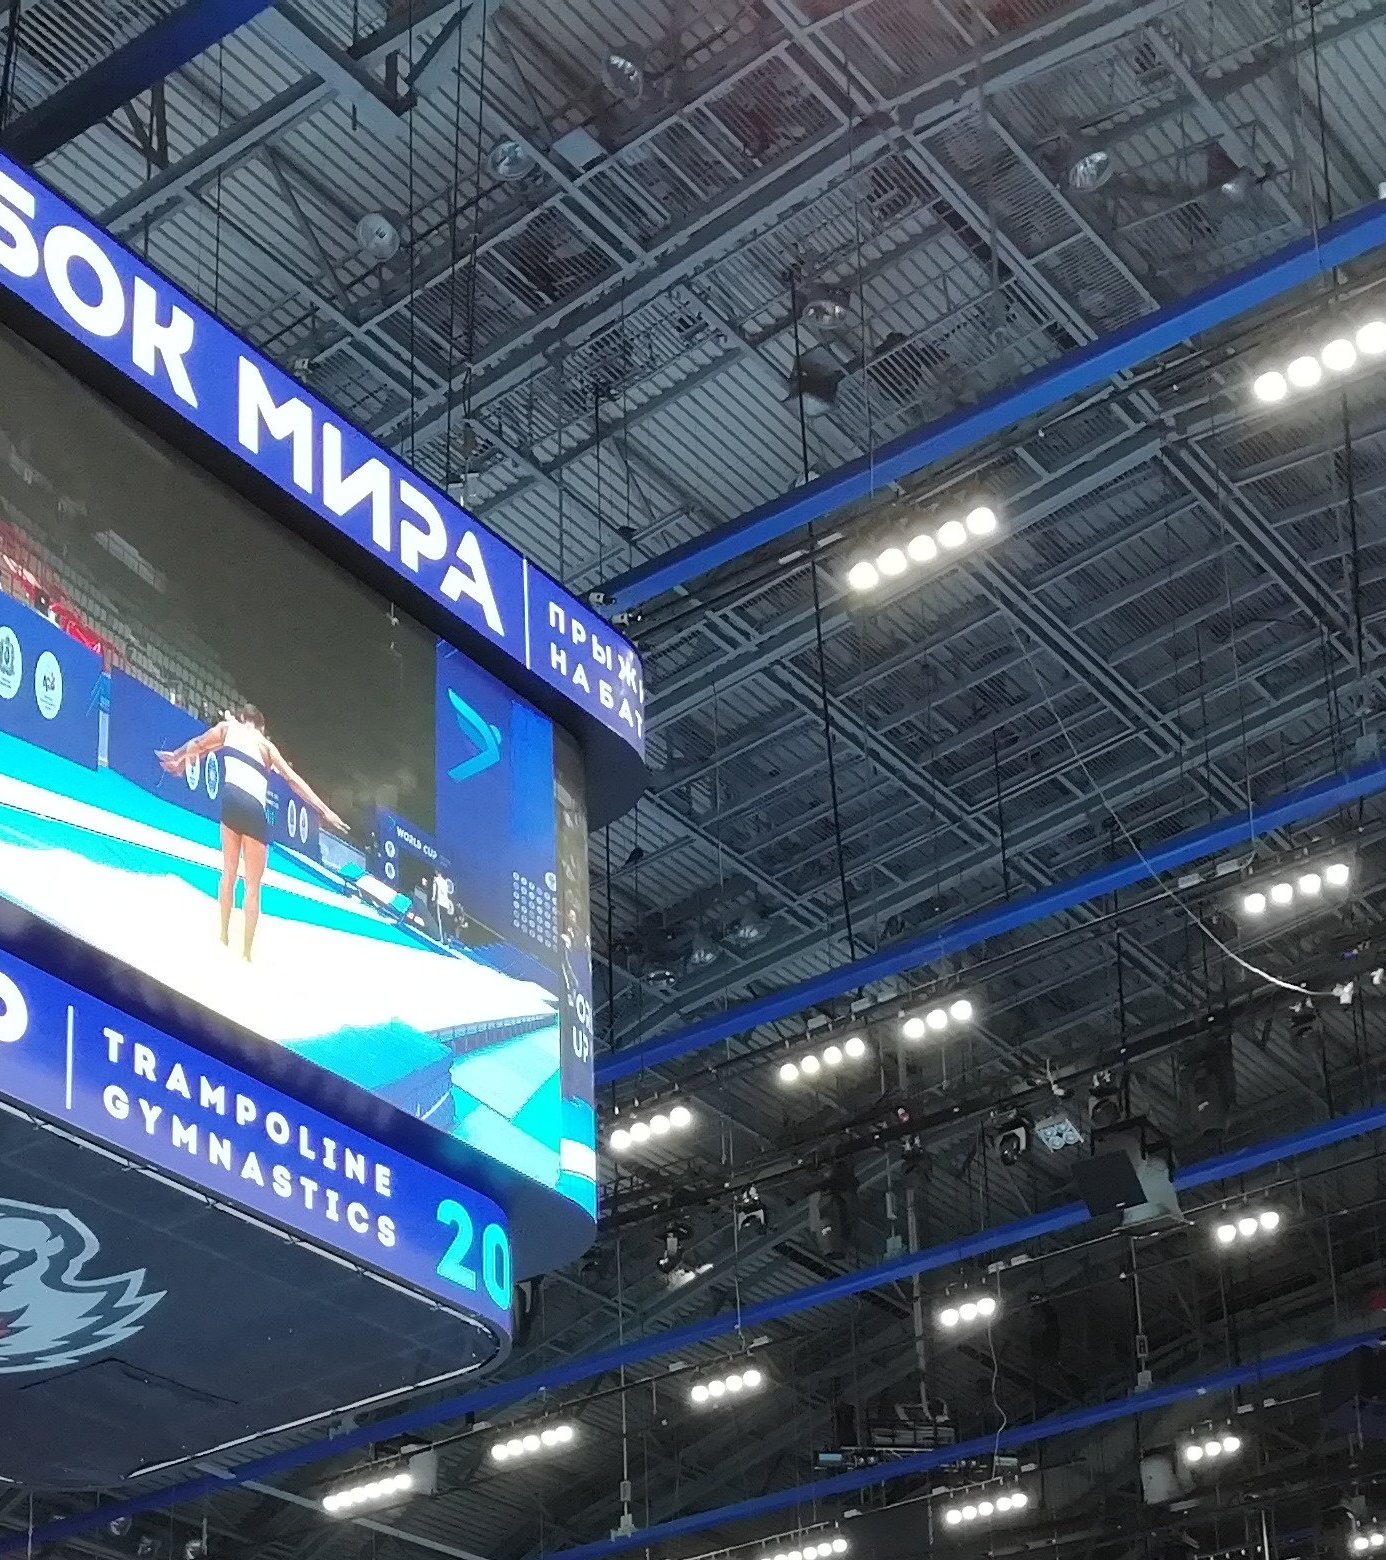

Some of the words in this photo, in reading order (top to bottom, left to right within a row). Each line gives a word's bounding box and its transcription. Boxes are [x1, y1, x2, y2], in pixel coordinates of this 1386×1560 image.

[239, 356, 505, 637] МИРА
[550, 641, 590, 693] НА
[102, 1090, 398, 1249] GYMNASTICS
[103, 1026, 395, 1198] TRAMPOLINE
